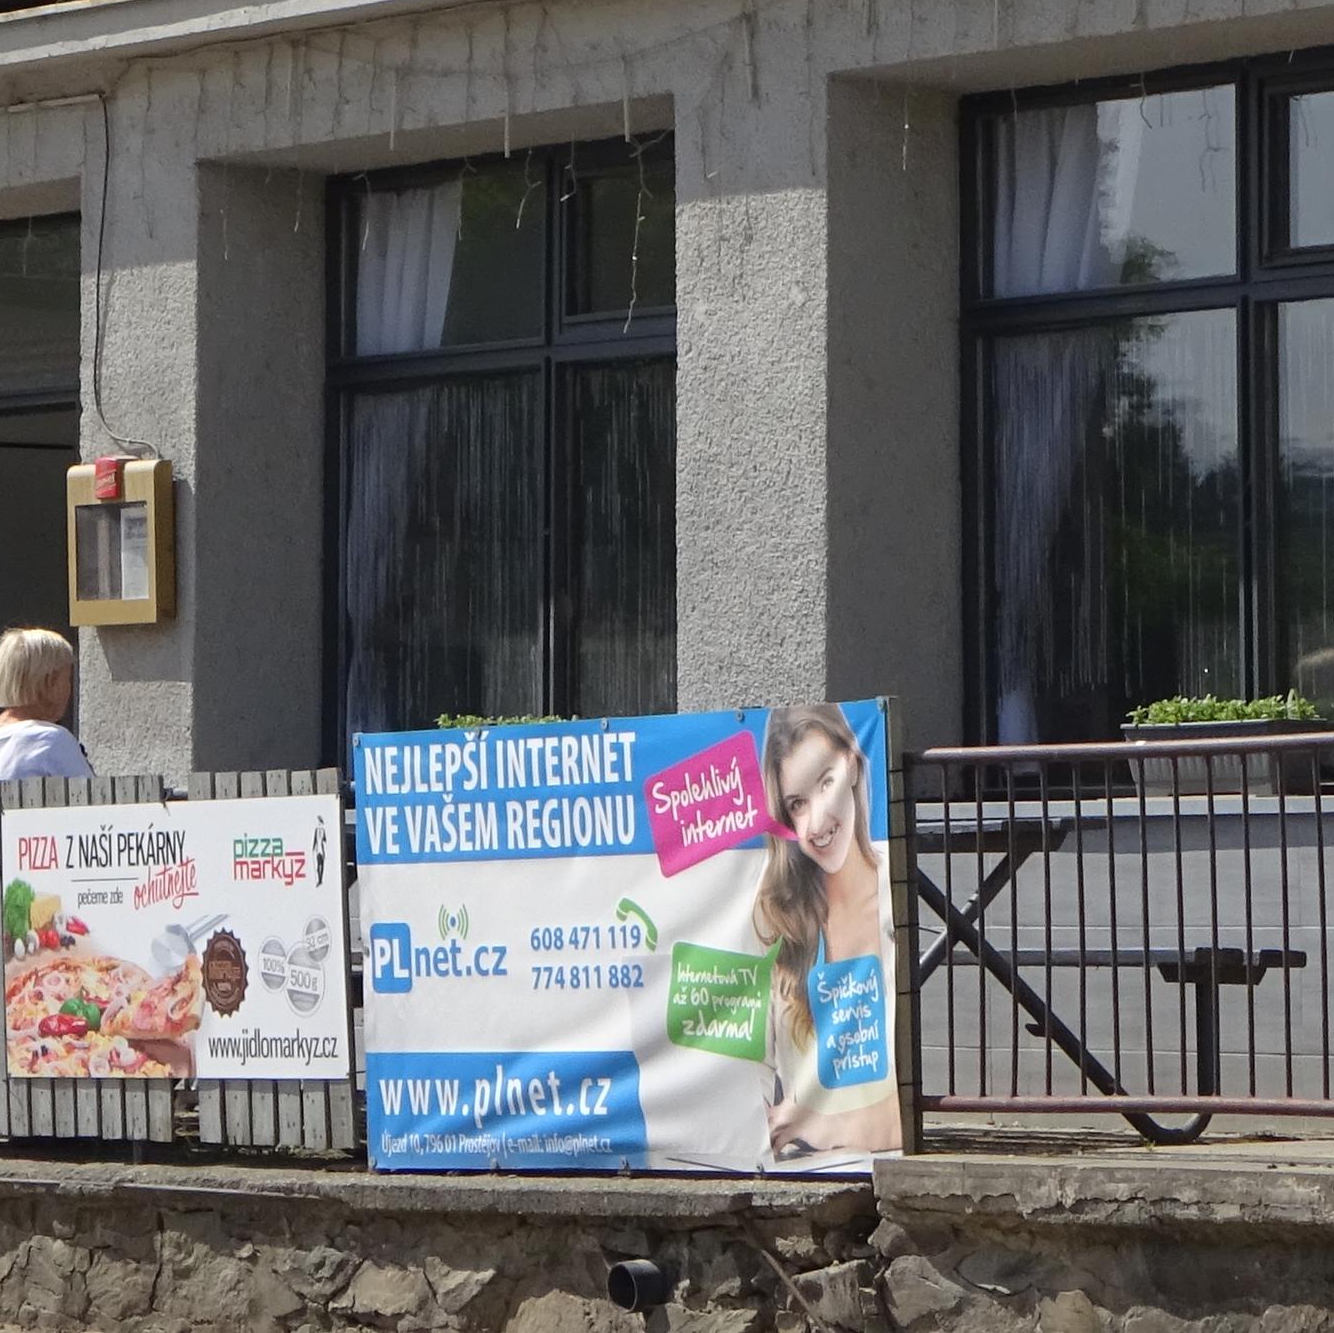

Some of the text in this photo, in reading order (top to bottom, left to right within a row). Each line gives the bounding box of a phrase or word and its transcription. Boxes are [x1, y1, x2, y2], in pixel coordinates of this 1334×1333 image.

[364, 730, 636, 795] NEJLEPŠÍ INTERNET
[652, 756, 743, 821] Spolehlivý
[364, 793, 636, 855] VE VAŠEM REGIONU
[680, 795, 758, 847] internet
[19, 822, 186, 871] PIZZA Z NAŠÍ PEKÁRNY
[233, 834, 284, 860] pizza
[133, 857, 199, 910] ochutnejte
[233, 852, 306, 887] markyz
[110, 886, 124, 904] zde
[530, 924, 641, 952] 608 471 119
[373, 938, 508, 978] PLnet.cz
[738, 964, 758, 987] TV
[290, 969, 312, 989] 500
[531, 964, 644, 990] 774 811 882
[817, 969, 879, 1009] Špičkový
[673, 985, 687, 1005] až
[690, 990, 709, 1006] 60
[832, 1001, 872, 1025] servis
[208, 1028, 338, 1066] www.jidlomarkyz.cz
[826, 1034, 836, 1049] a
[379, 1064, 612, 1129] www.plnet.cz
